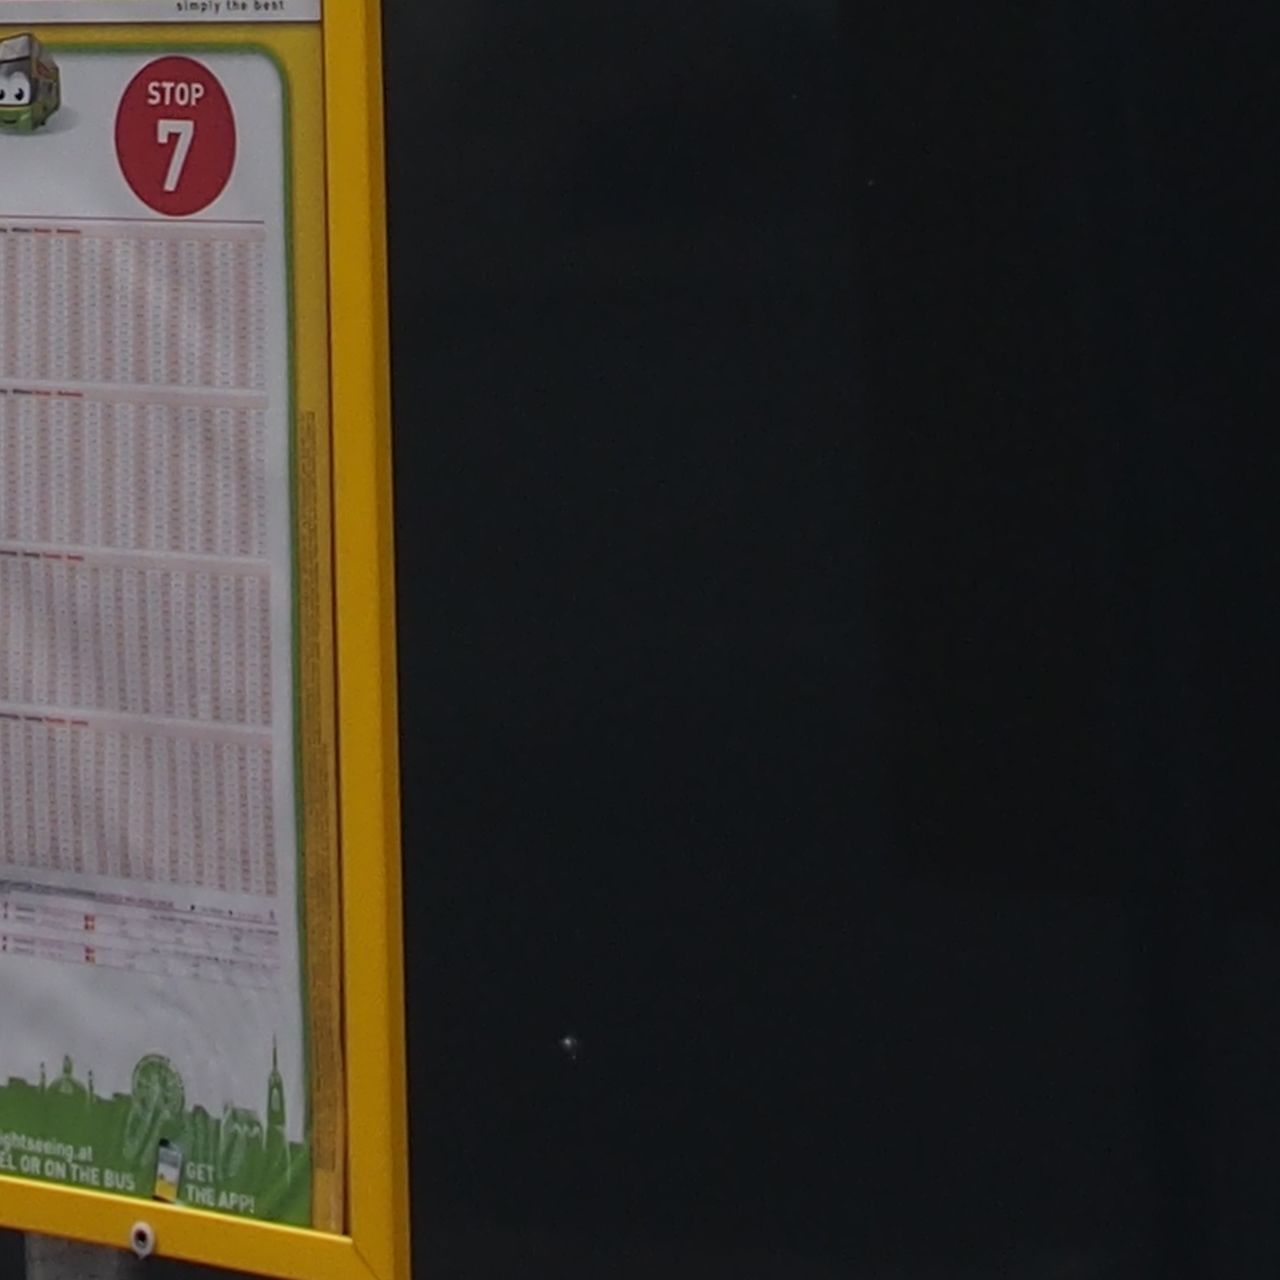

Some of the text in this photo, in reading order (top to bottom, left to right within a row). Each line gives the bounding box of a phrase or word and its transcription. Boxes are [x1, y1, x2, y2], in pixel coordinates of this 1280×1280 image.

[176, 0, 285, 14] simply the best
[146, 80, 205, 107] STOP
[155, 119, 195, 192] 7
[20, 1153, 41, 1174] OR
[45, 1157, 67, 1179] ON
[70, 1163, 100, 1186] THE
[104, 1168, 135, 1191] BUS
[185, 1161, 215, 1183] GET
[185, 1183, 256, 1214] THE APP!
